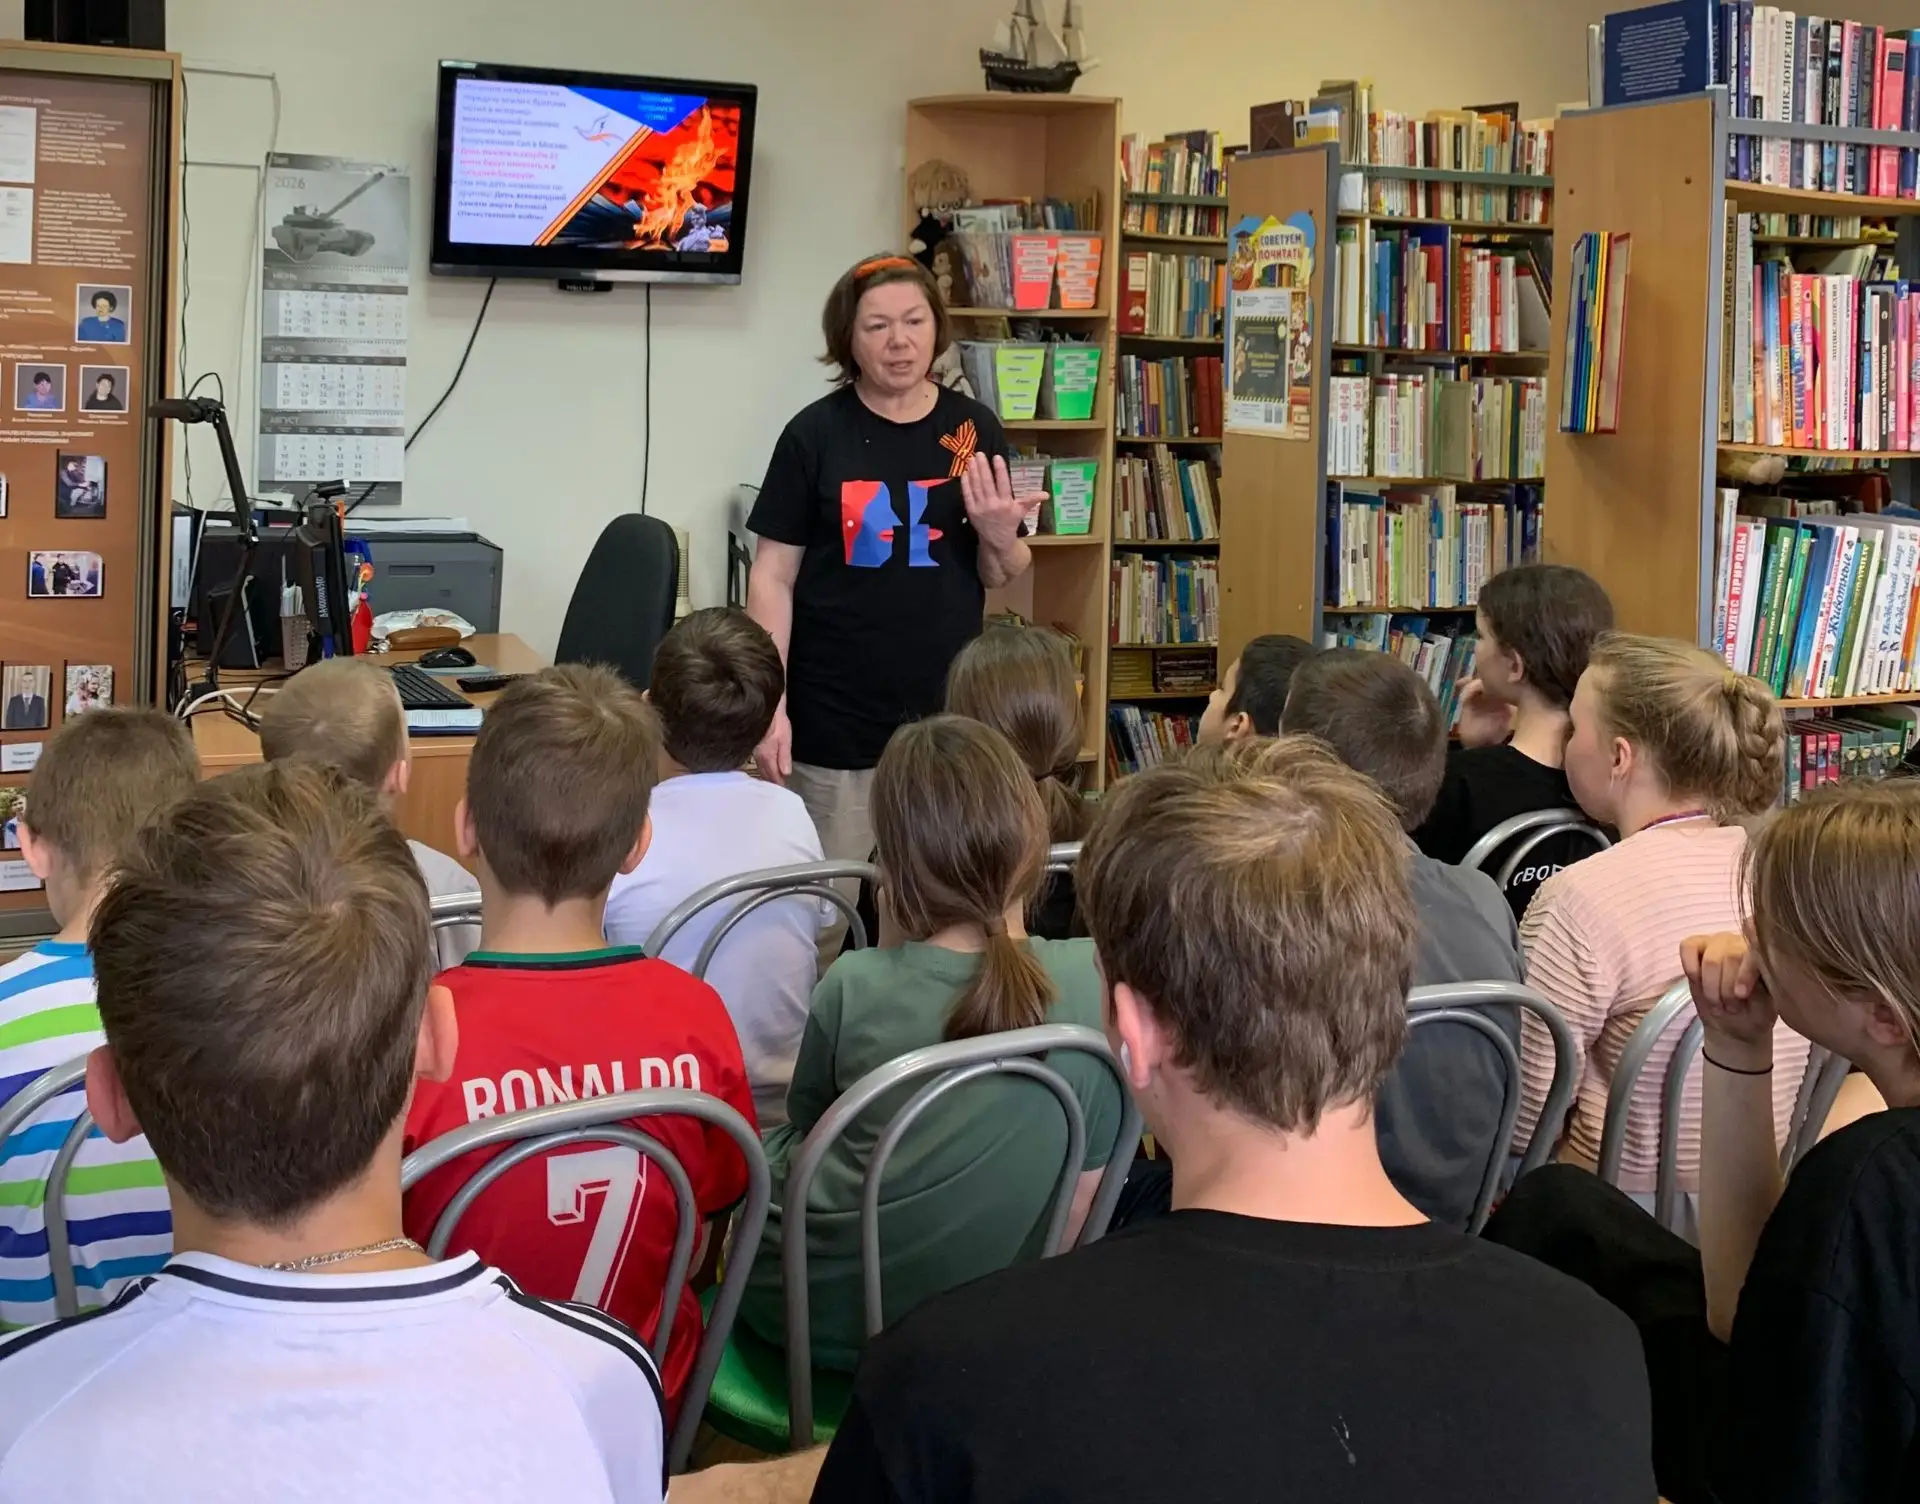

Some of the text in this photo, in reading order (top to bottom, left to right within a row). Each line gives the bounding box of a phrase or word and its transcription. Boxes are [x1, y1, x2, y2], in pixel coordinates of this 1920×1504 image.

[1781, 20, 1792, 121] ЦИКЛОПЕДИЯ
[274, 177, 306, 189] 2026
[1257, 248, 1302, 261] ПОЧИТАТЬ
[1260, 233, 1302, 246] СОВЕТУЕМ
[1726, 216, 1734, 271] РОССИИ
[1724, 276, 1732, 318] АТЛАС
[1793, 361, 1804, 430] ПАМЯТЬ
[1731, 533, 1747, 594] ПРИРОДЫ
[1727, 600, 1739, 640] ЧУДЕС
[1828, 553, 1852, 638] Животные
[1882, 572, 1898, 635] Подводный
[1894, 573, 1910, 635] Подводный
[462, 1054, 701, 1124] RONALDO
[546, 1146, 647, 1312] 7
